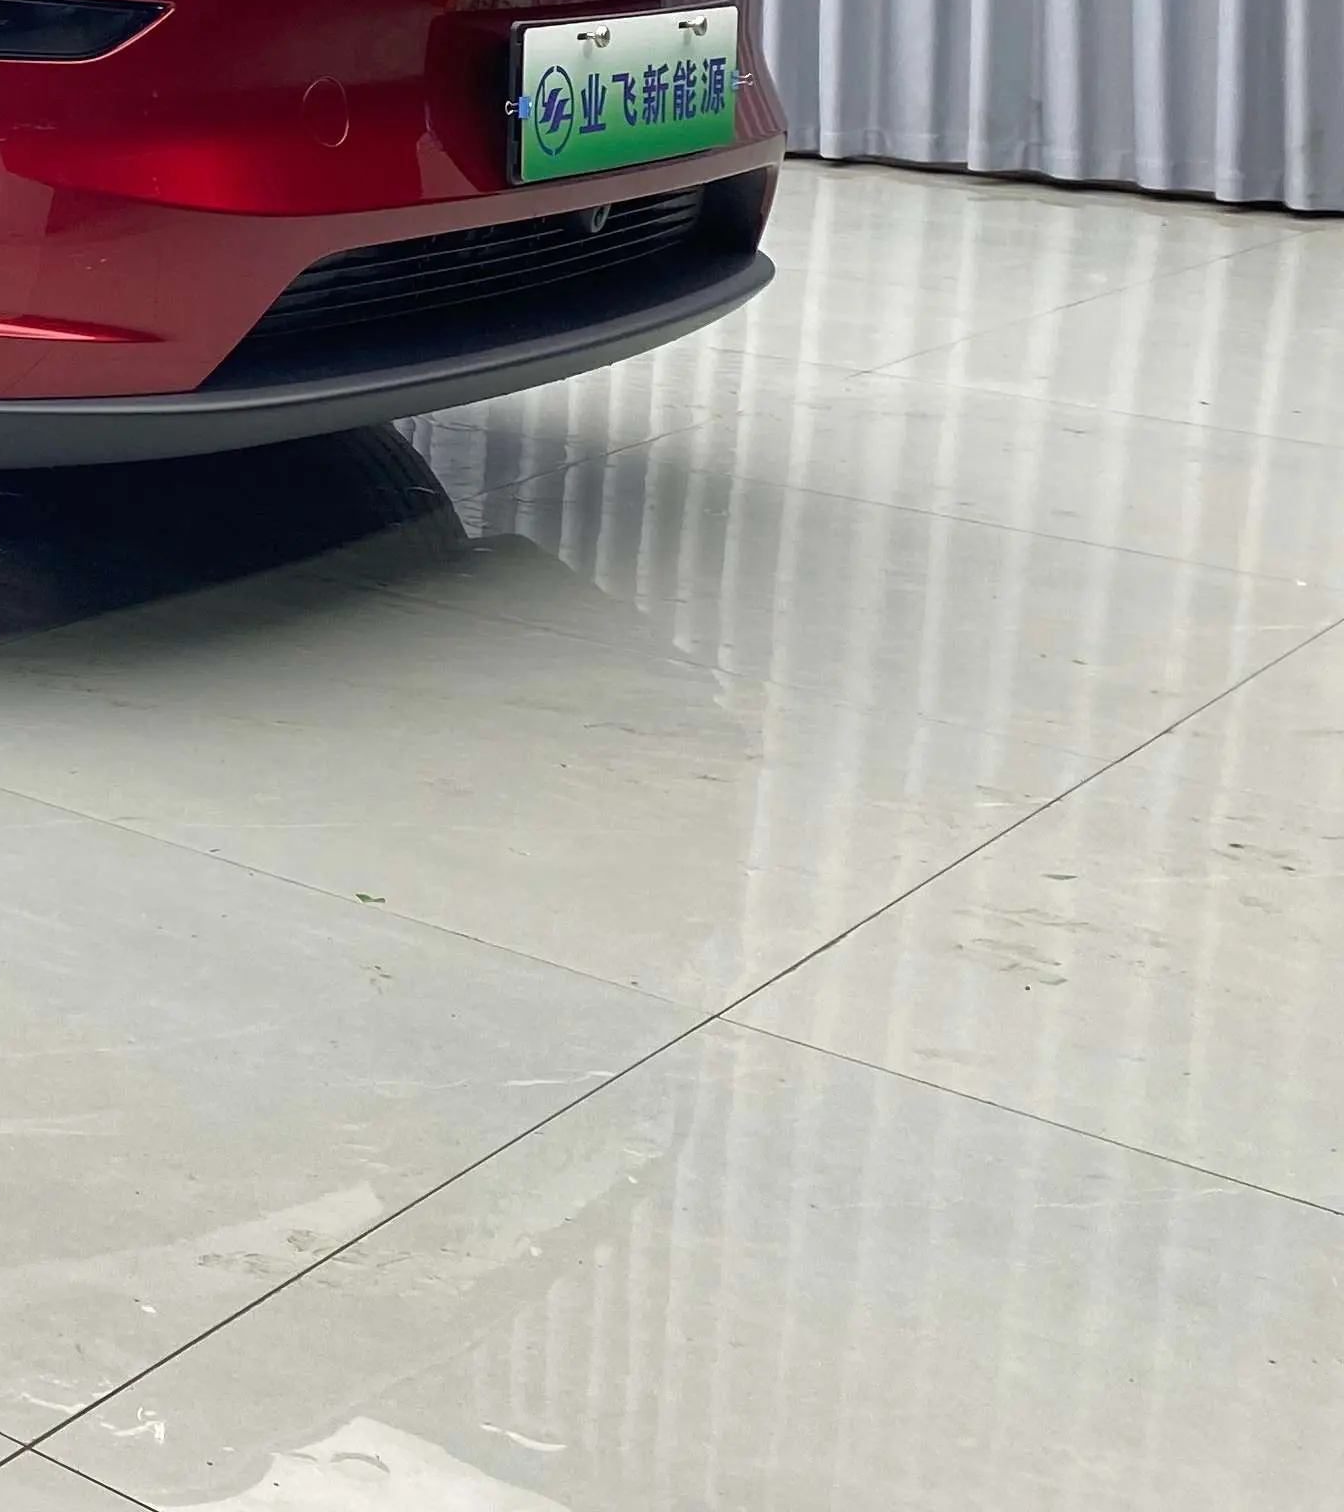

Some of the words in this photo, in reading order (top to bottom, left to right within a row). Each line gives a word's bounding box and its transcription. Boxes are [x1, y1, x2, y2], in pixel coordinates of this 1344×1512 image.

[578, 57, 727, 135] 业飞新能源
